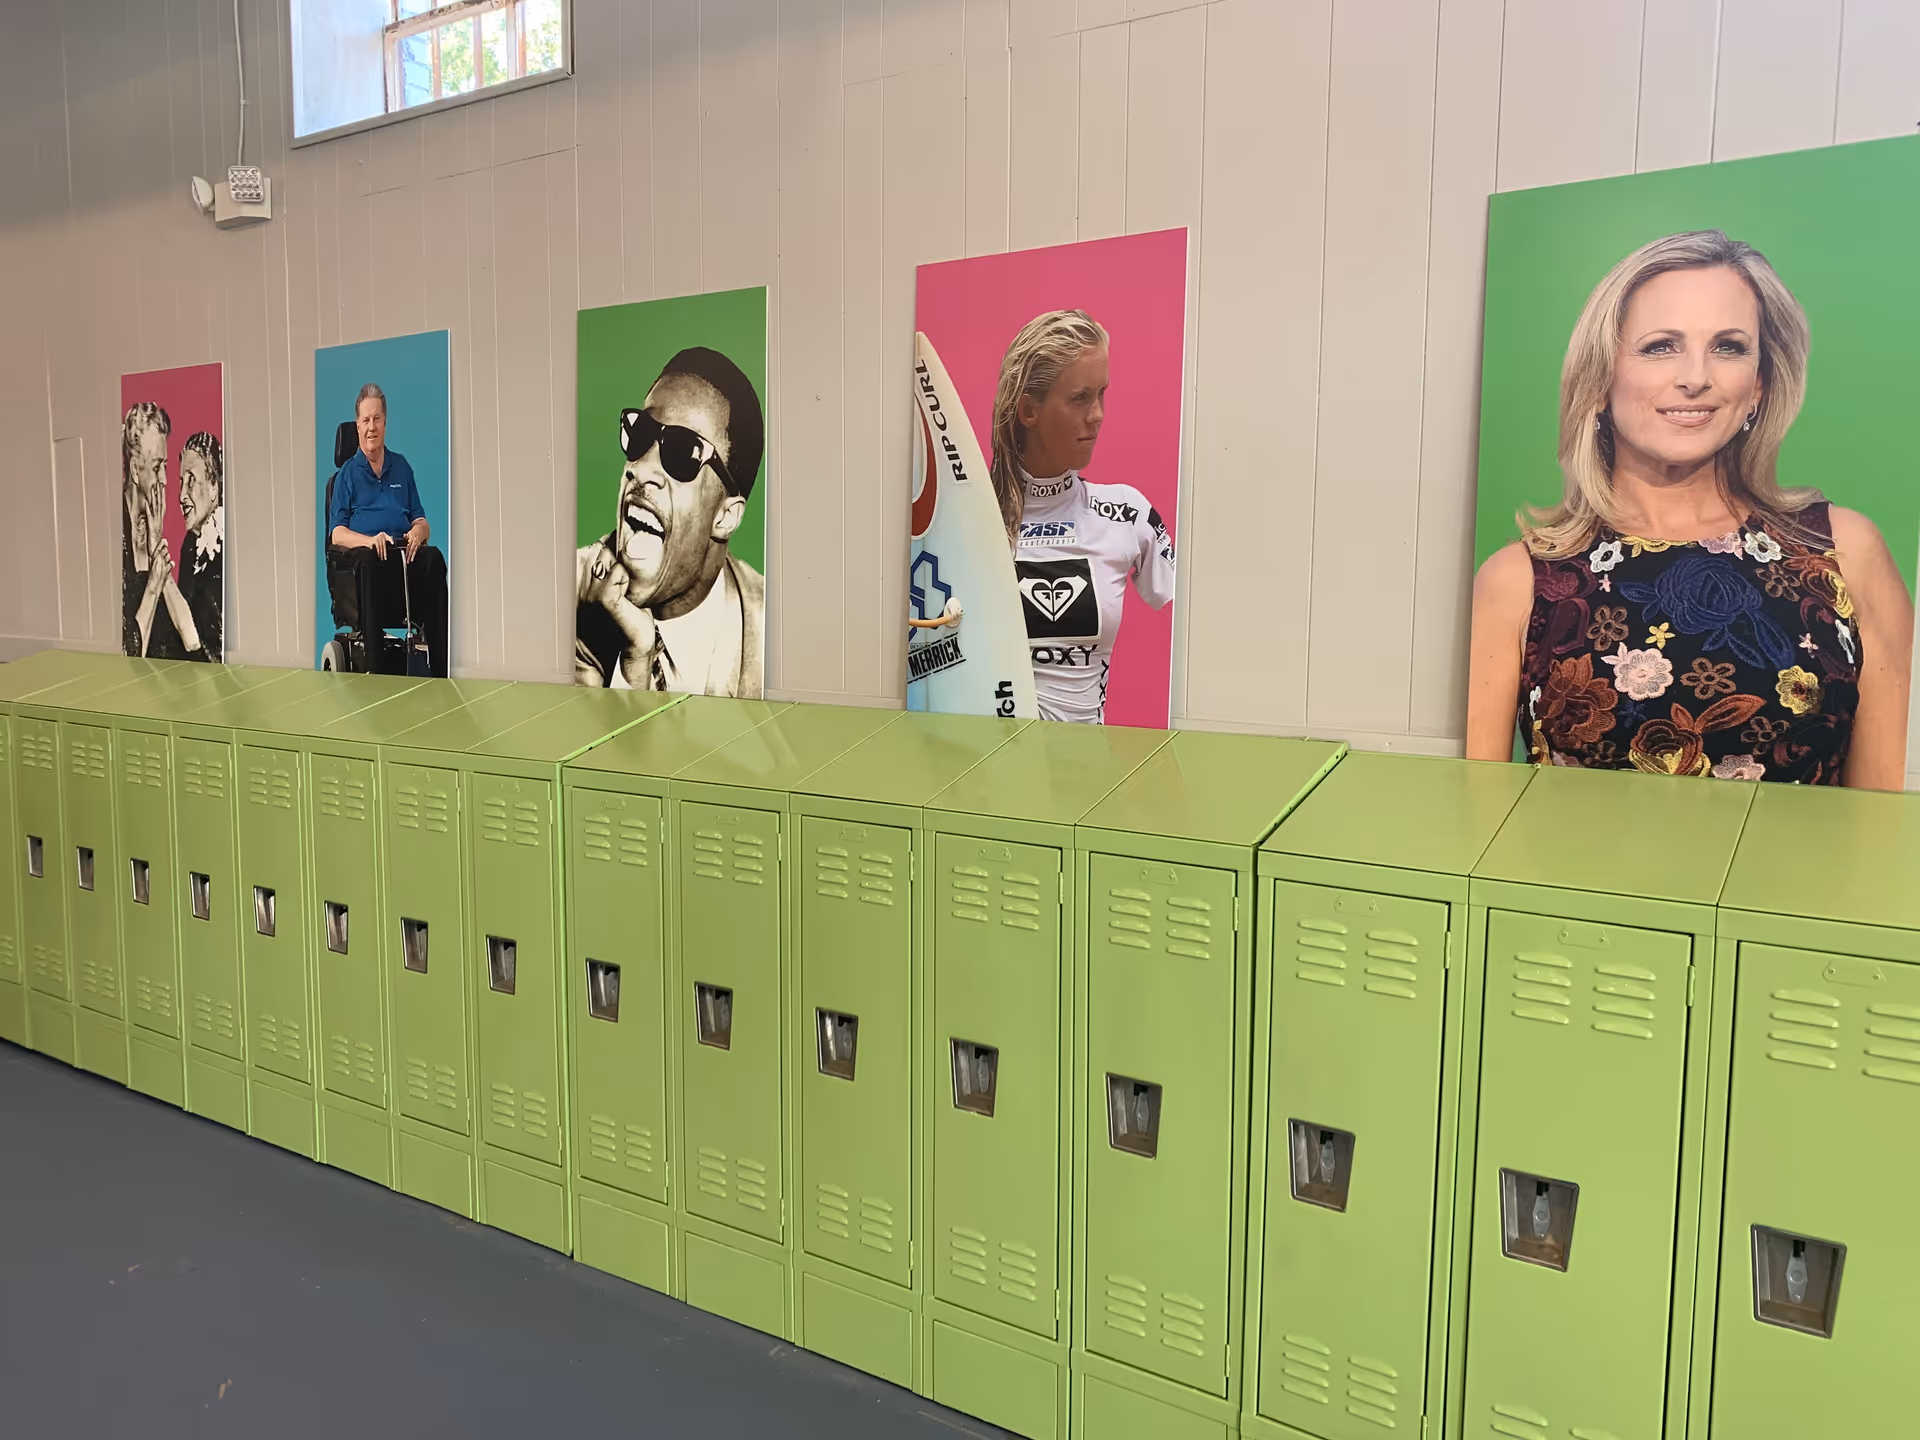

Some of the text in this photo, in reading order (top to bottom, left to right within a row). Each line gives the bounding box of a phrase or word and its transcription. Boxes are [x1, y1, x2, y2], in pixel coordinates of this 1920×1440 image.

[915, 359, 968, 481] RIP CURL
[1031, 483, 1062, 497] ROXY
[908, 637, 962, 677] MERRICK
